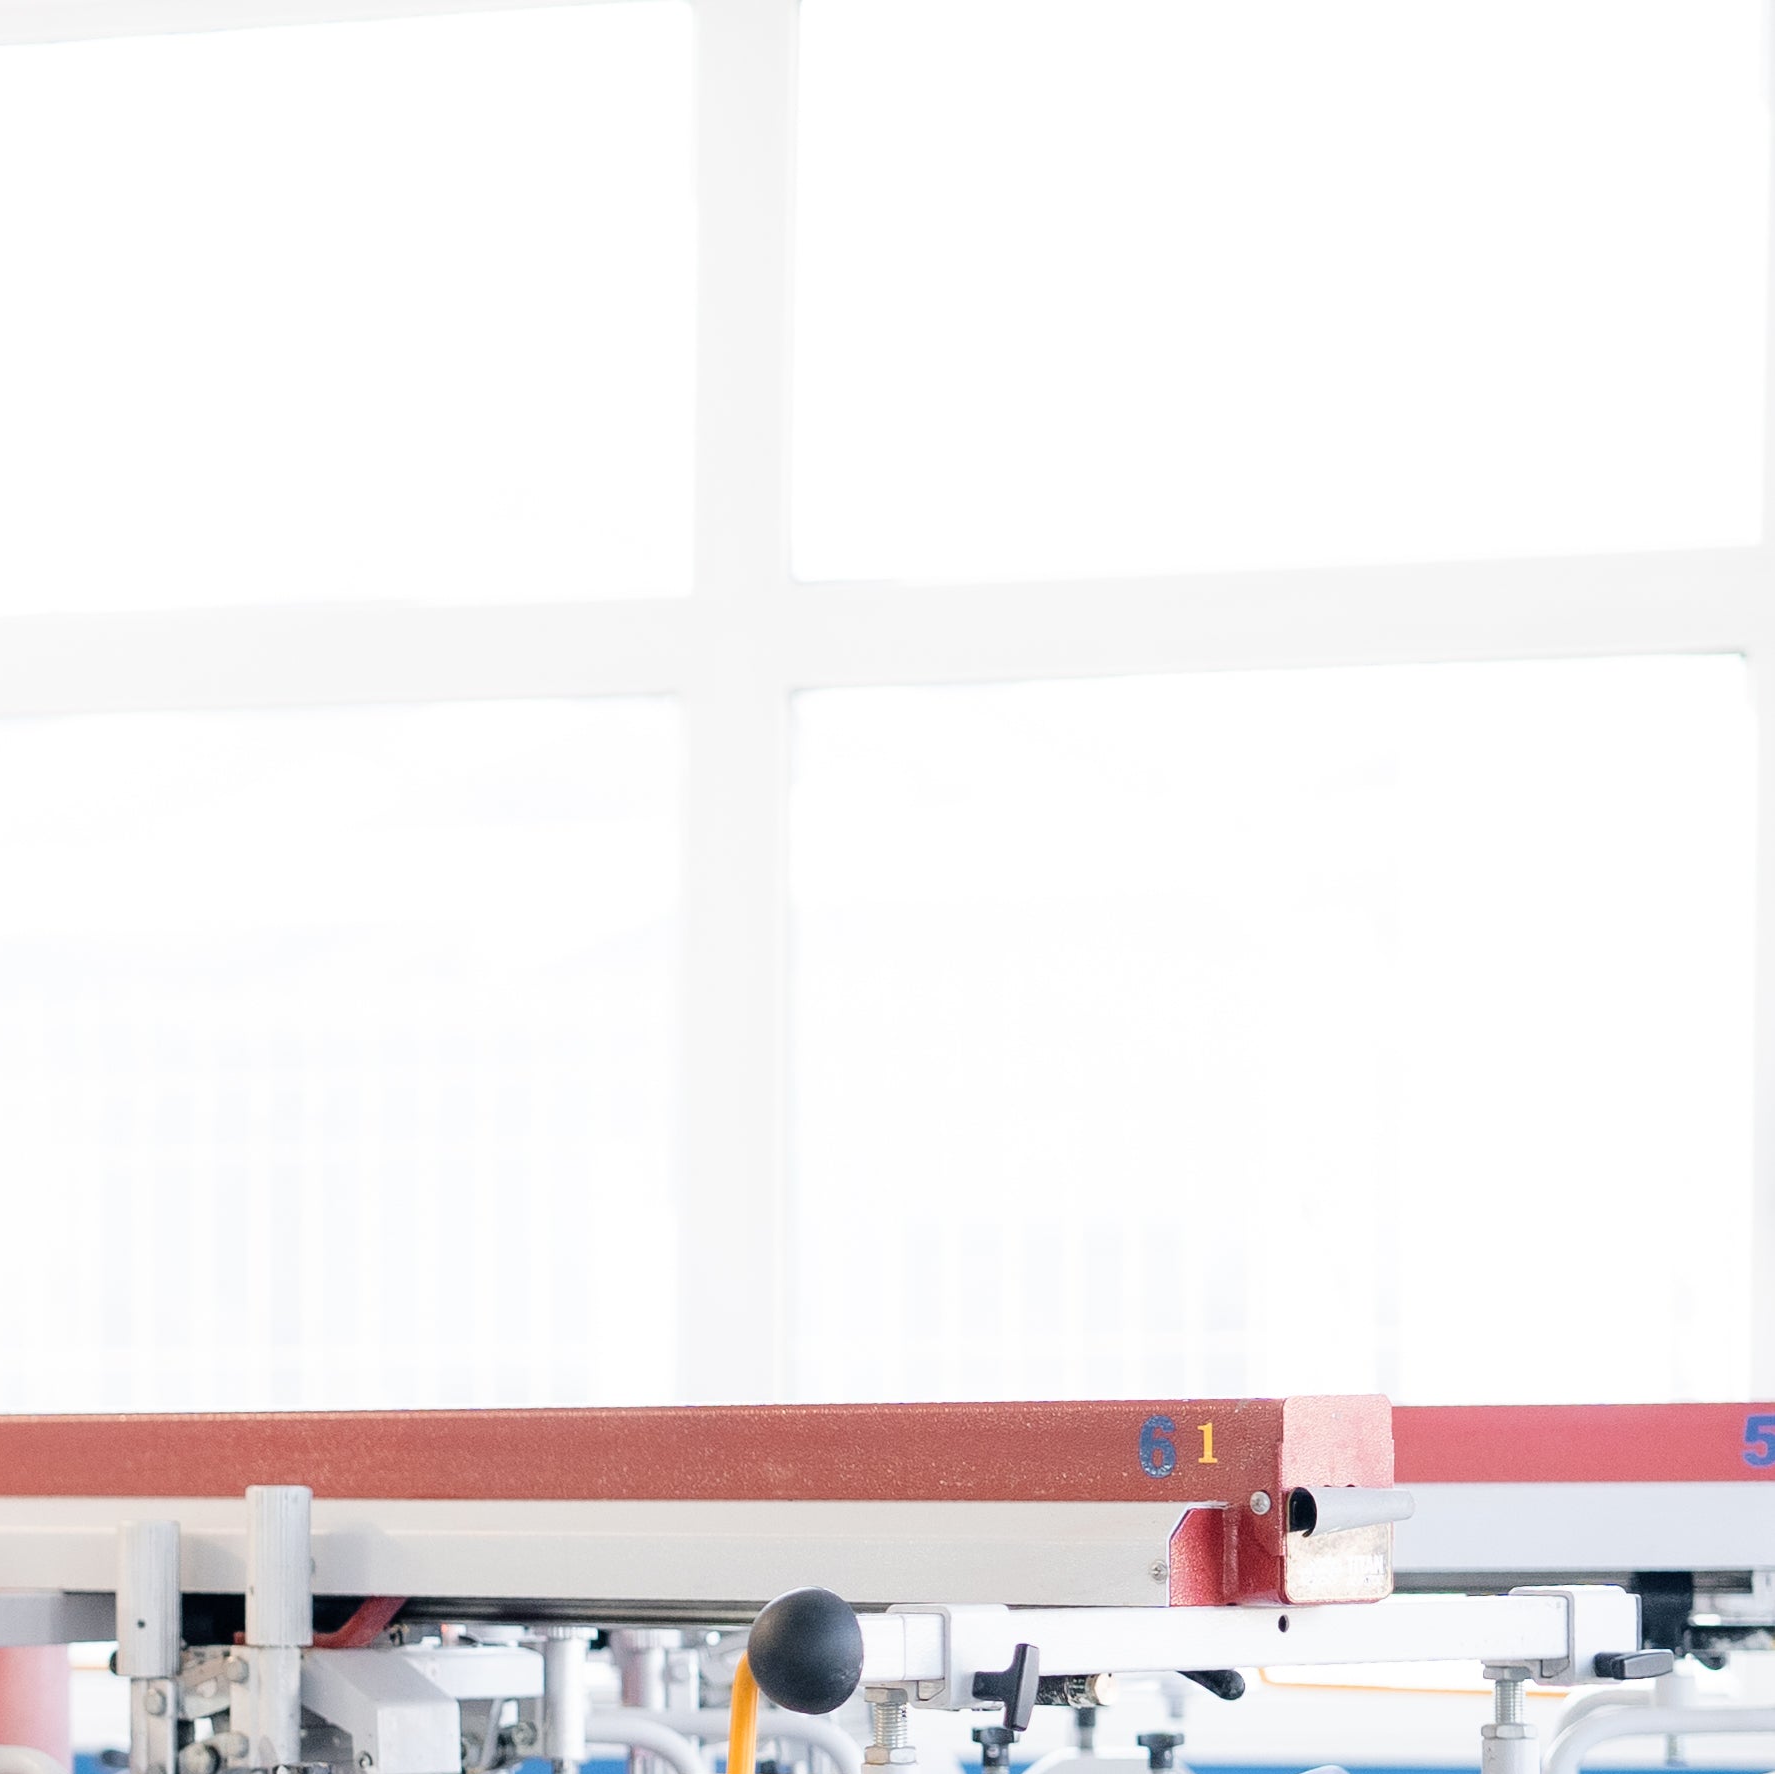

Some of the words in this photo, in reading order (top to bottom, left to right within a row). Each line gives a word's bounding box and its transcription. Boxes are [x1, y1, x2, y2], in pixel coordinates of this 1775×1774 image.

[1139, 1414, 1176, 1479] 6
[1197, 1421, 1218, 1464] 1
[1742, 1413, 1775, 1468] 5
